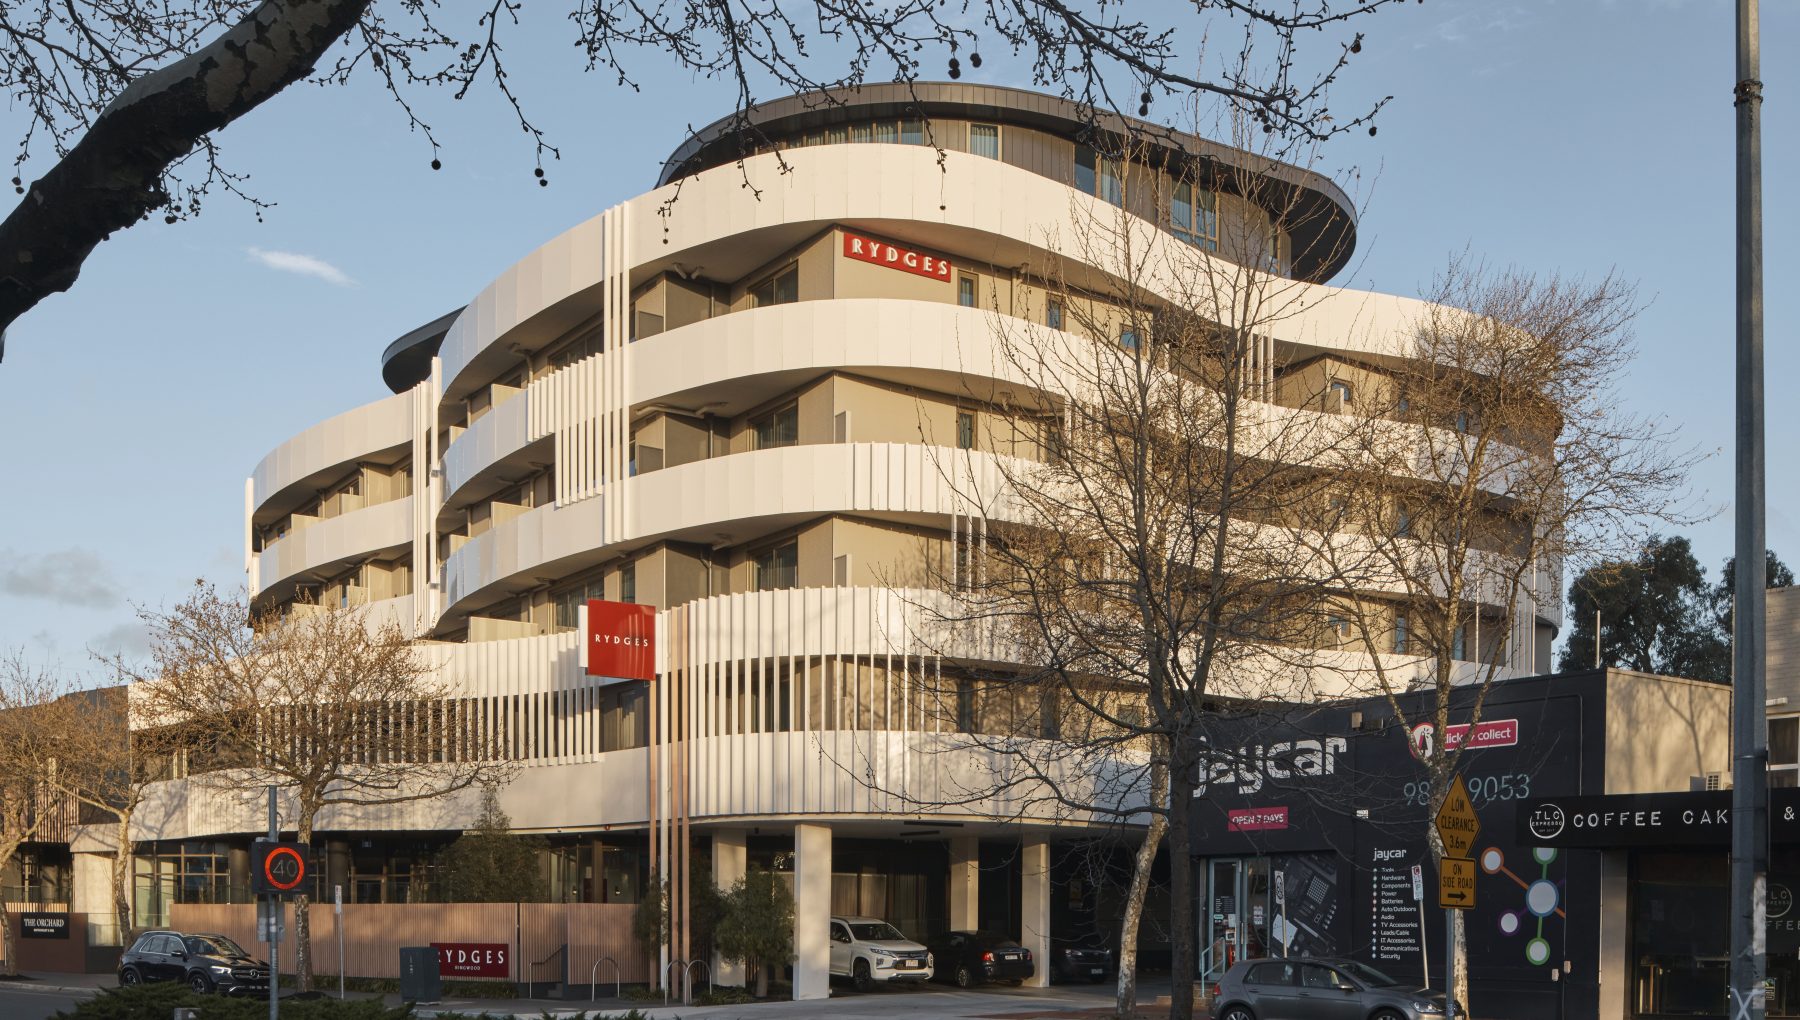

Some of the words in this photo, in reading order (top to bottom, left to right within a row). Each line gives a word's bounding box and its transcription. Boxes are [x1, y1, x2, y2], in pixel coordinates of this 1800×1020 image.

[852, 238, 947, 275] RYDGES
[595, 633, 648, 647] RYDGES
[1445, 731, 1463, 744] lick
[1477, 727, 1511, 741] collect
[1193, 736, 1346, 798] jaycar
[1468, 774, 1530, 802] 9053
[1451, 799, 1464, 812] LOW
[1232, 815, 1255, 825] OPEN
[1263, 813, 1284, 823] DAYS
[1535, 810, 1560, 820] TLC
[1573, 811, 1662, 827] COFFEE
[1682, 809, 1728, 825] CAK
[1783, 806, 1795, 821] &
[1441, 815, 1475, 832] CLEARANCE
[1449, 835, 1466, 849] 3.6m
[1373, 848, 1407, 861] jaycar
[272, 859, 298, 878] 40
[1453, 863, 1462, 875] ON
[1442, 877, 1455, 888] SIDE
[1457, 877, 1473, 889] ROAD
[24, 918, 36, 927] THE
[36, 918, 64, 928] ORCHARD
[438, 949, 504, 964] YDGES
